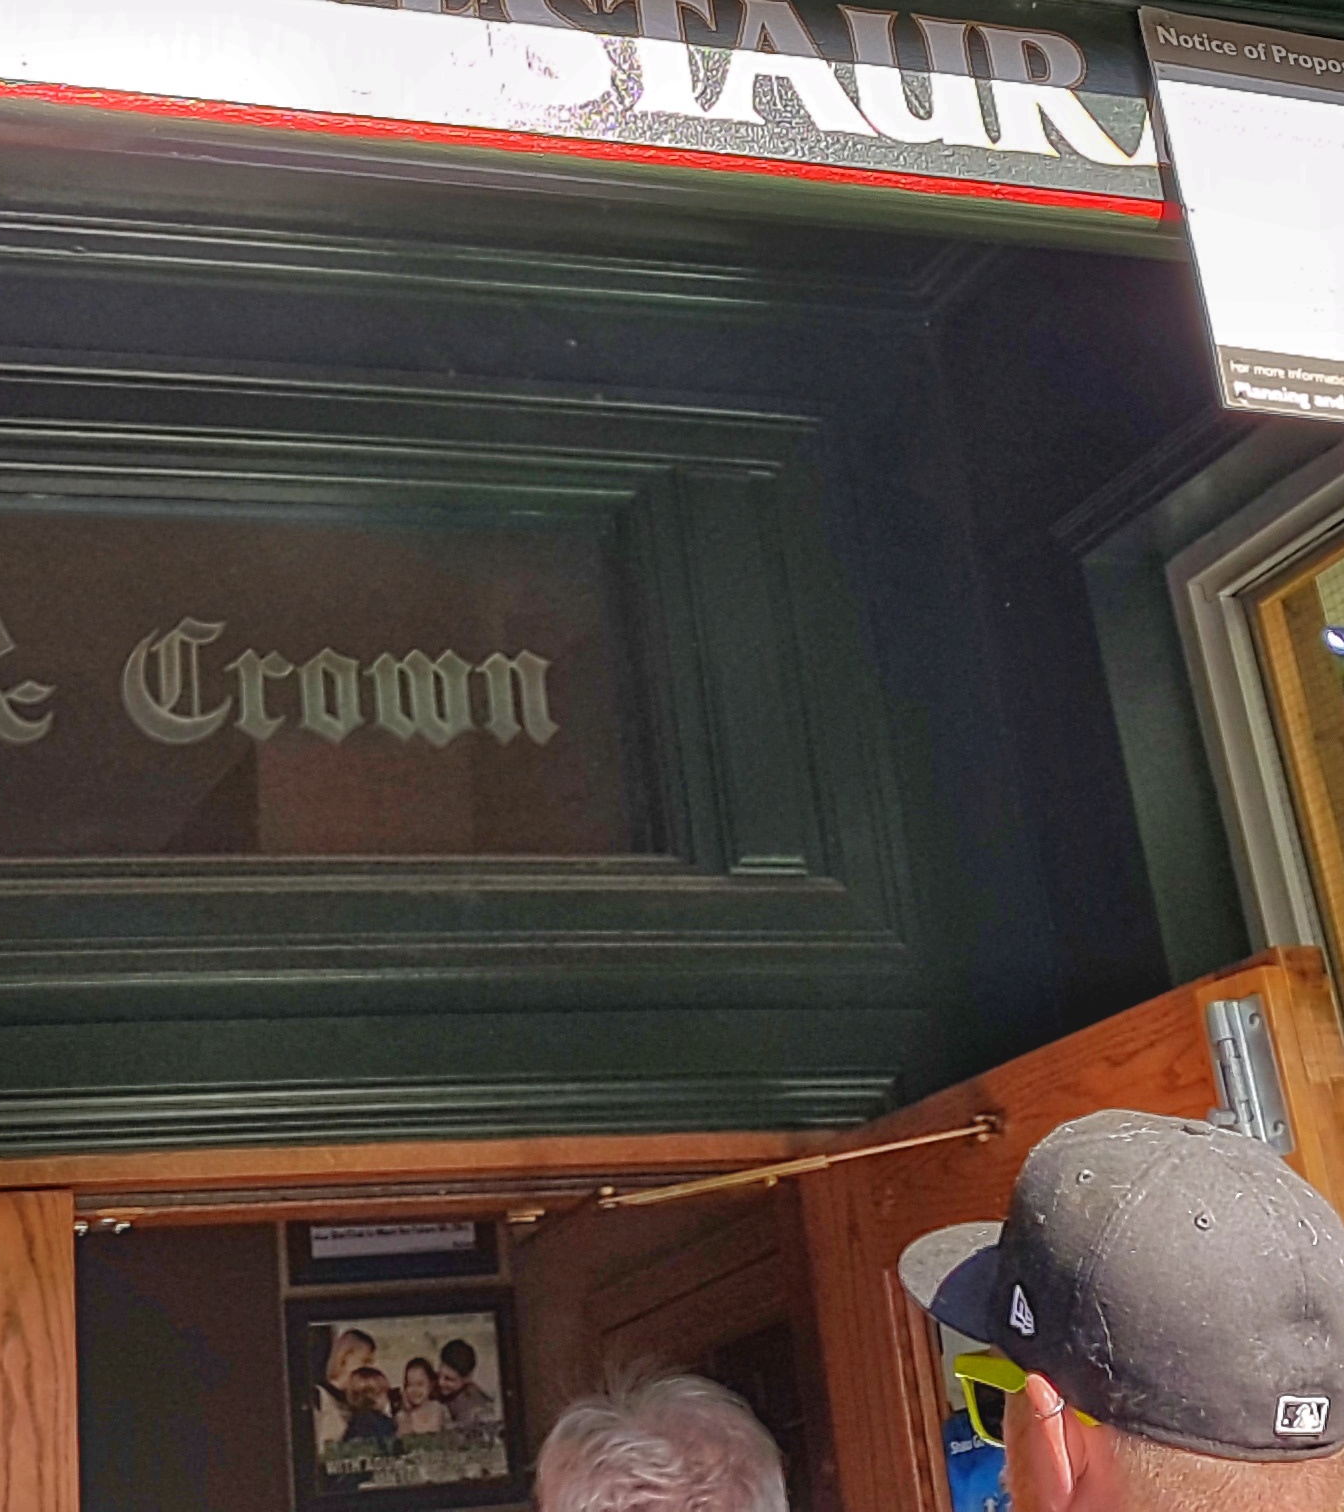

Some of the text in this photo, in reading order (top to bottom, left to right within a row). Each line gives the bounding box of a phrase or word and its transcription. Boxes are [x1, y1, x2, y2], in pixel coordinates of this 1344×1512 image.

[1155, 25, 1238, 56] Notice
[1244, 42, 1267, 62] of
[1233, 380, 1312, 411] Planning
[120, 616, 562, 747] Crown
